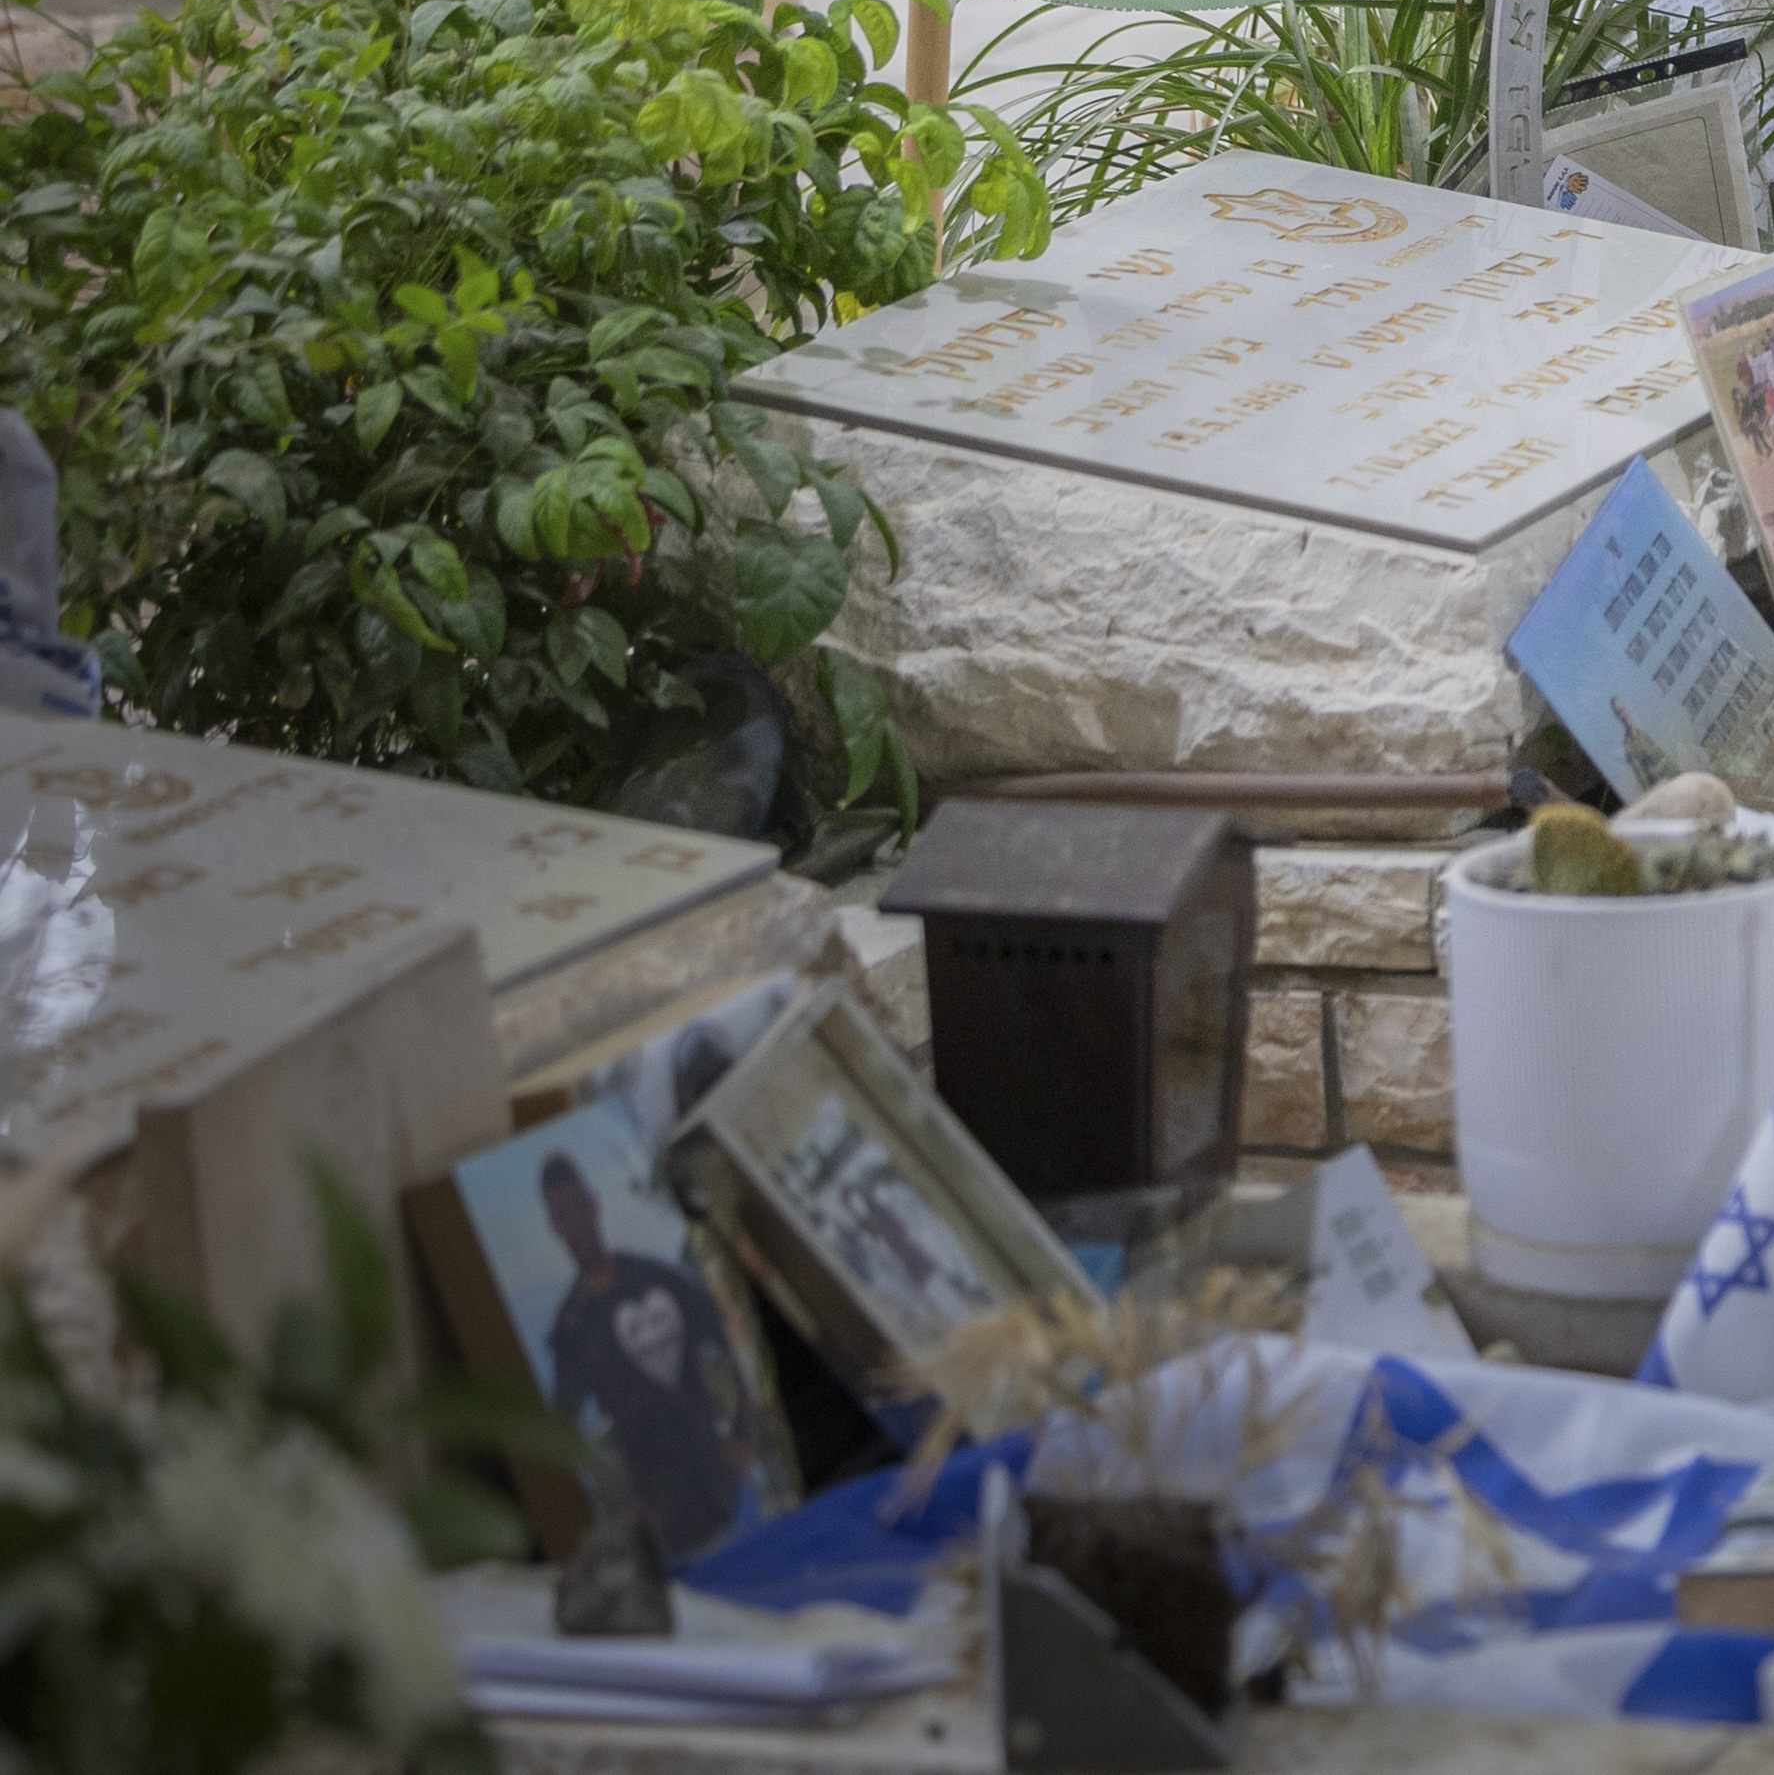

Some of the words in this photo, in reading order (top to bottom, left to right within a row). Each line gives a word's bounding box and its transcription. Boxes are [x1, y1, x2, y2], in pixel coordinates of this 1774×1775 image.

[1086, 248, 1176, 281] ישי
[1242, 259, 1305, 282] בן
[1441, 251, 1560, 302] בסיוון
[1155, 280, 1253, 320] טליה
[1291, 276, 1392, 309] נולד
[1502, 291, 1599, 324] נפל
[1096, 317, 1172, 351] יונה
[1166, 336, 1268, 379] בעין
[965, 352, 1111, 414] ושמואל
[1331, 368, 1455, 422] בקרב
[1147, 380, 1307, 453] 19.5.1999
[1325, 417, 1480, 492] 7.10.2023
